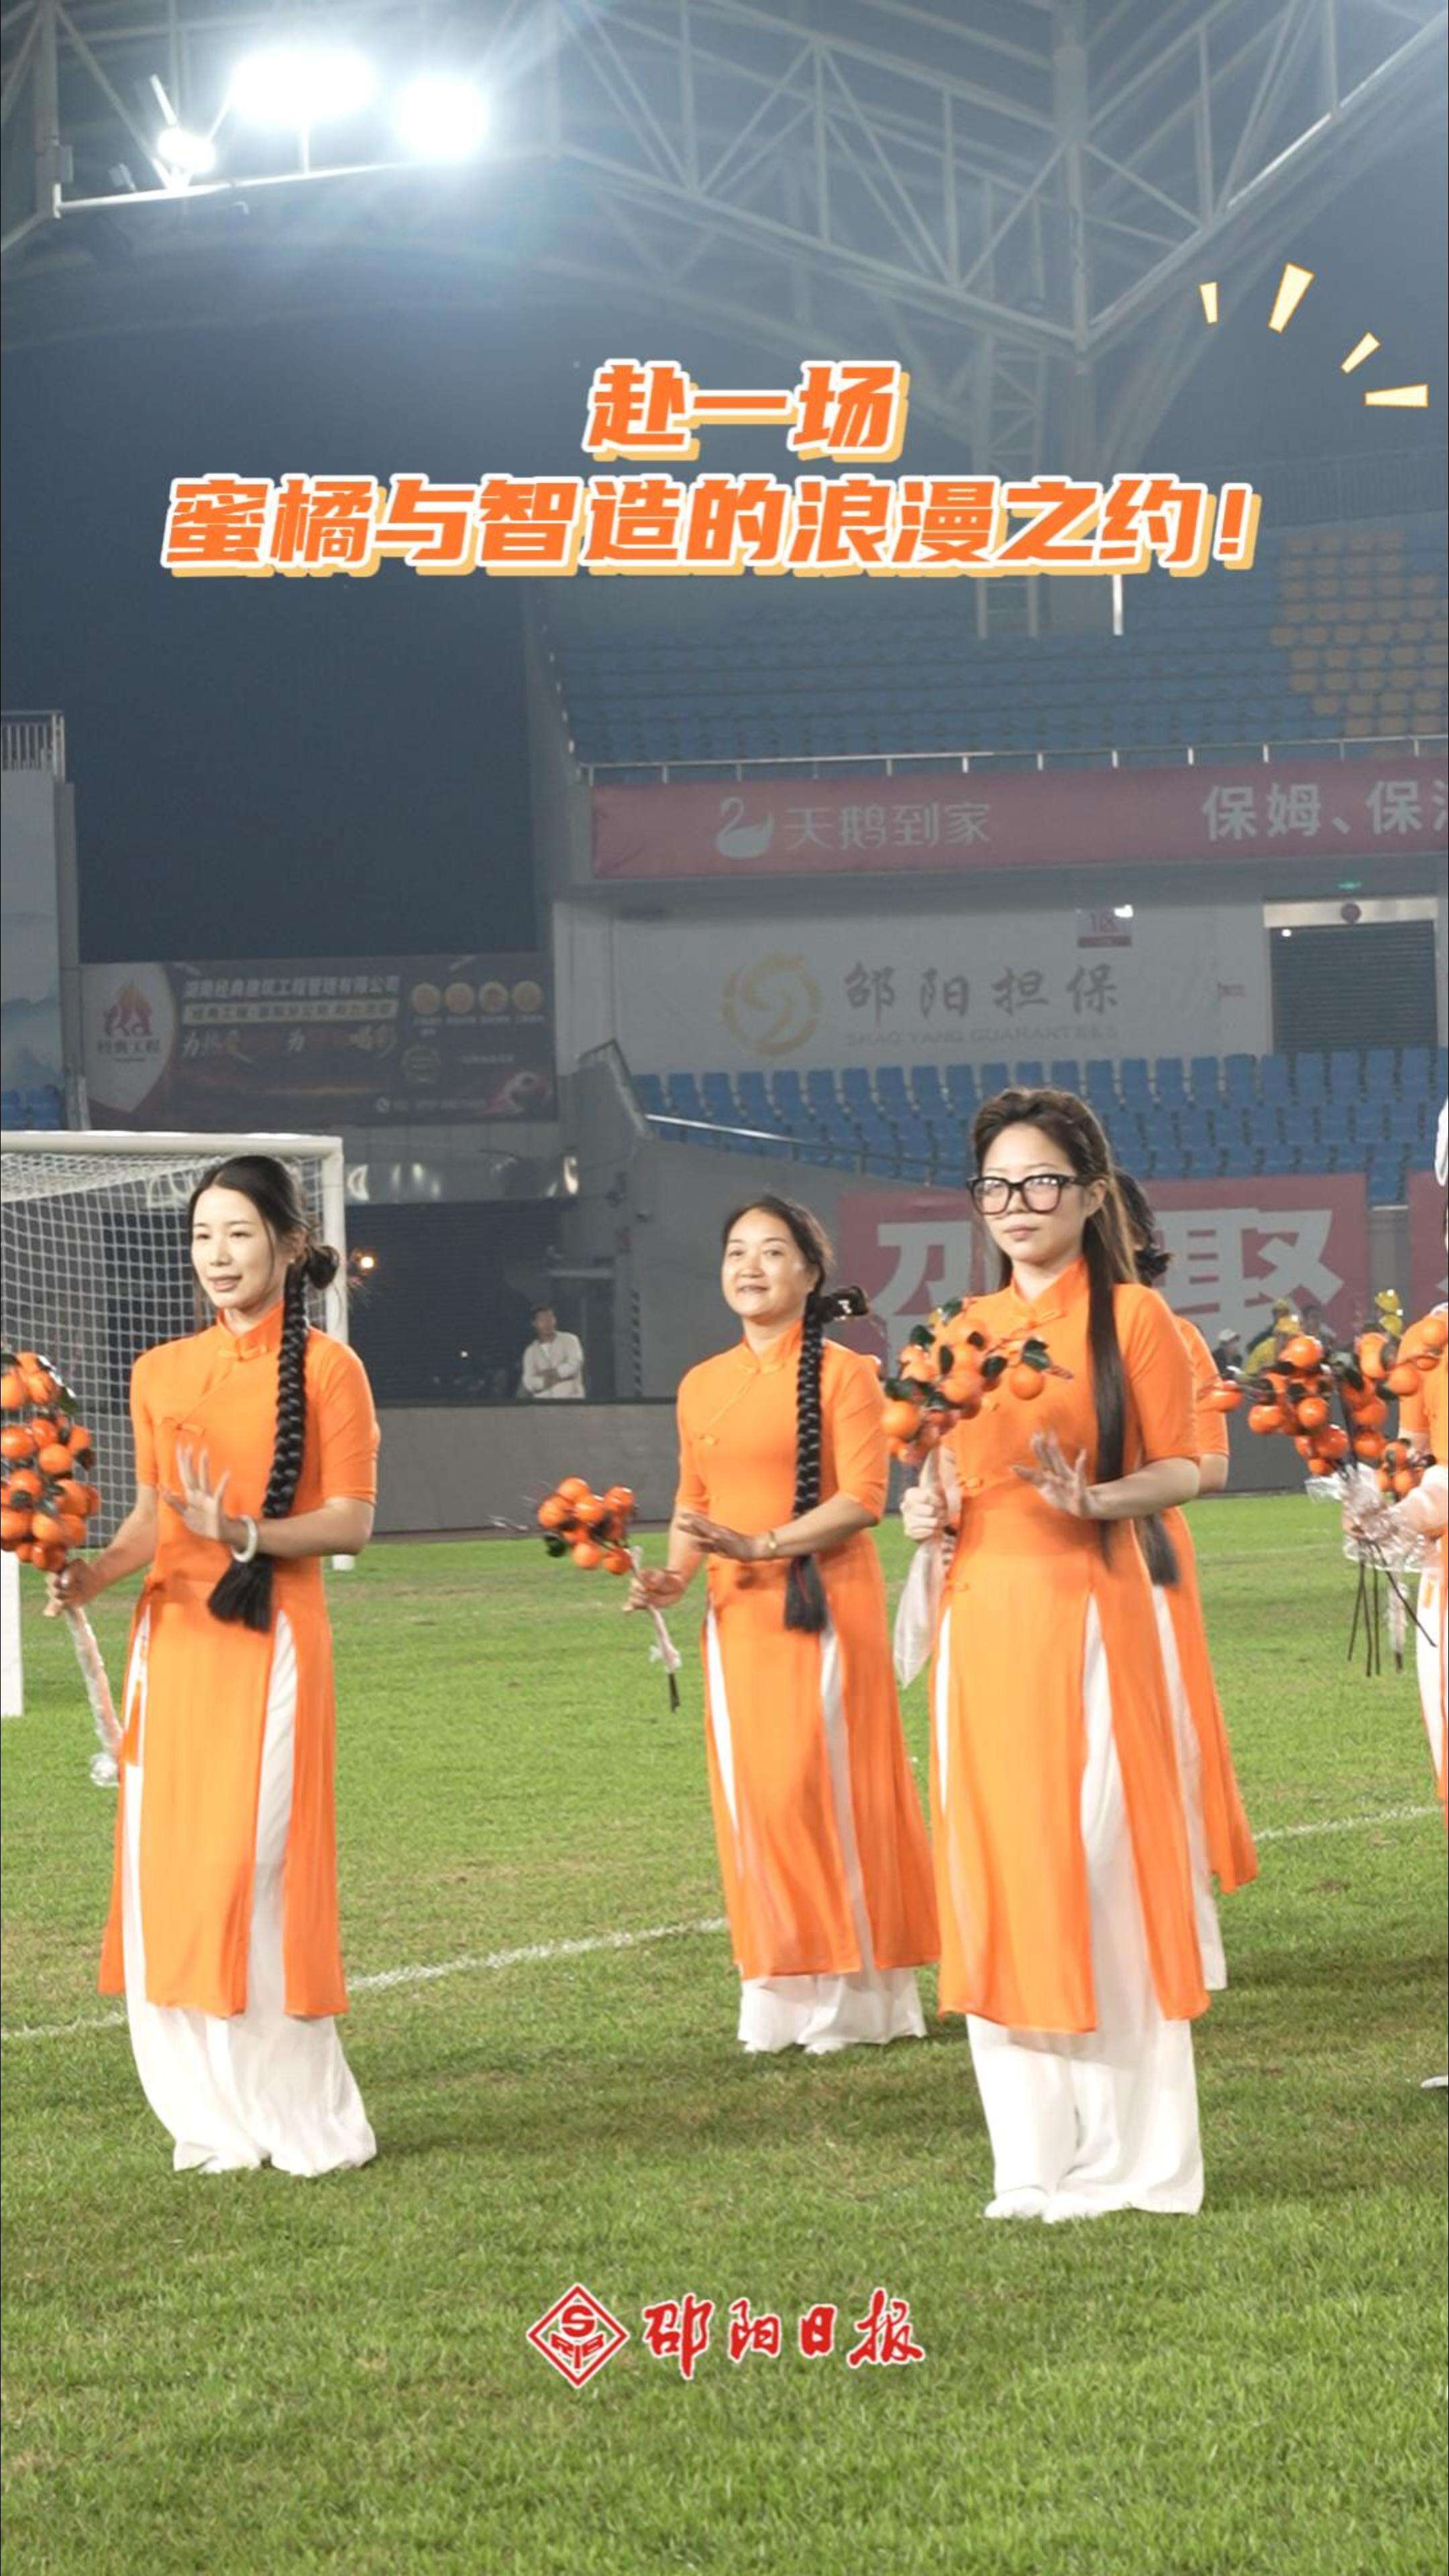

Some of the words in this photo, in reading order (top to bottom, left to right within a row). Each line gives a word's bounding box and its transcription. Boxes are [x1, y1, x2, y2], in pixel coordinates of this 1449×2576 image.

[784, 802, 991, 850] 天鹅到家
[844, 961, 1118, 1028] 邵阳担保
